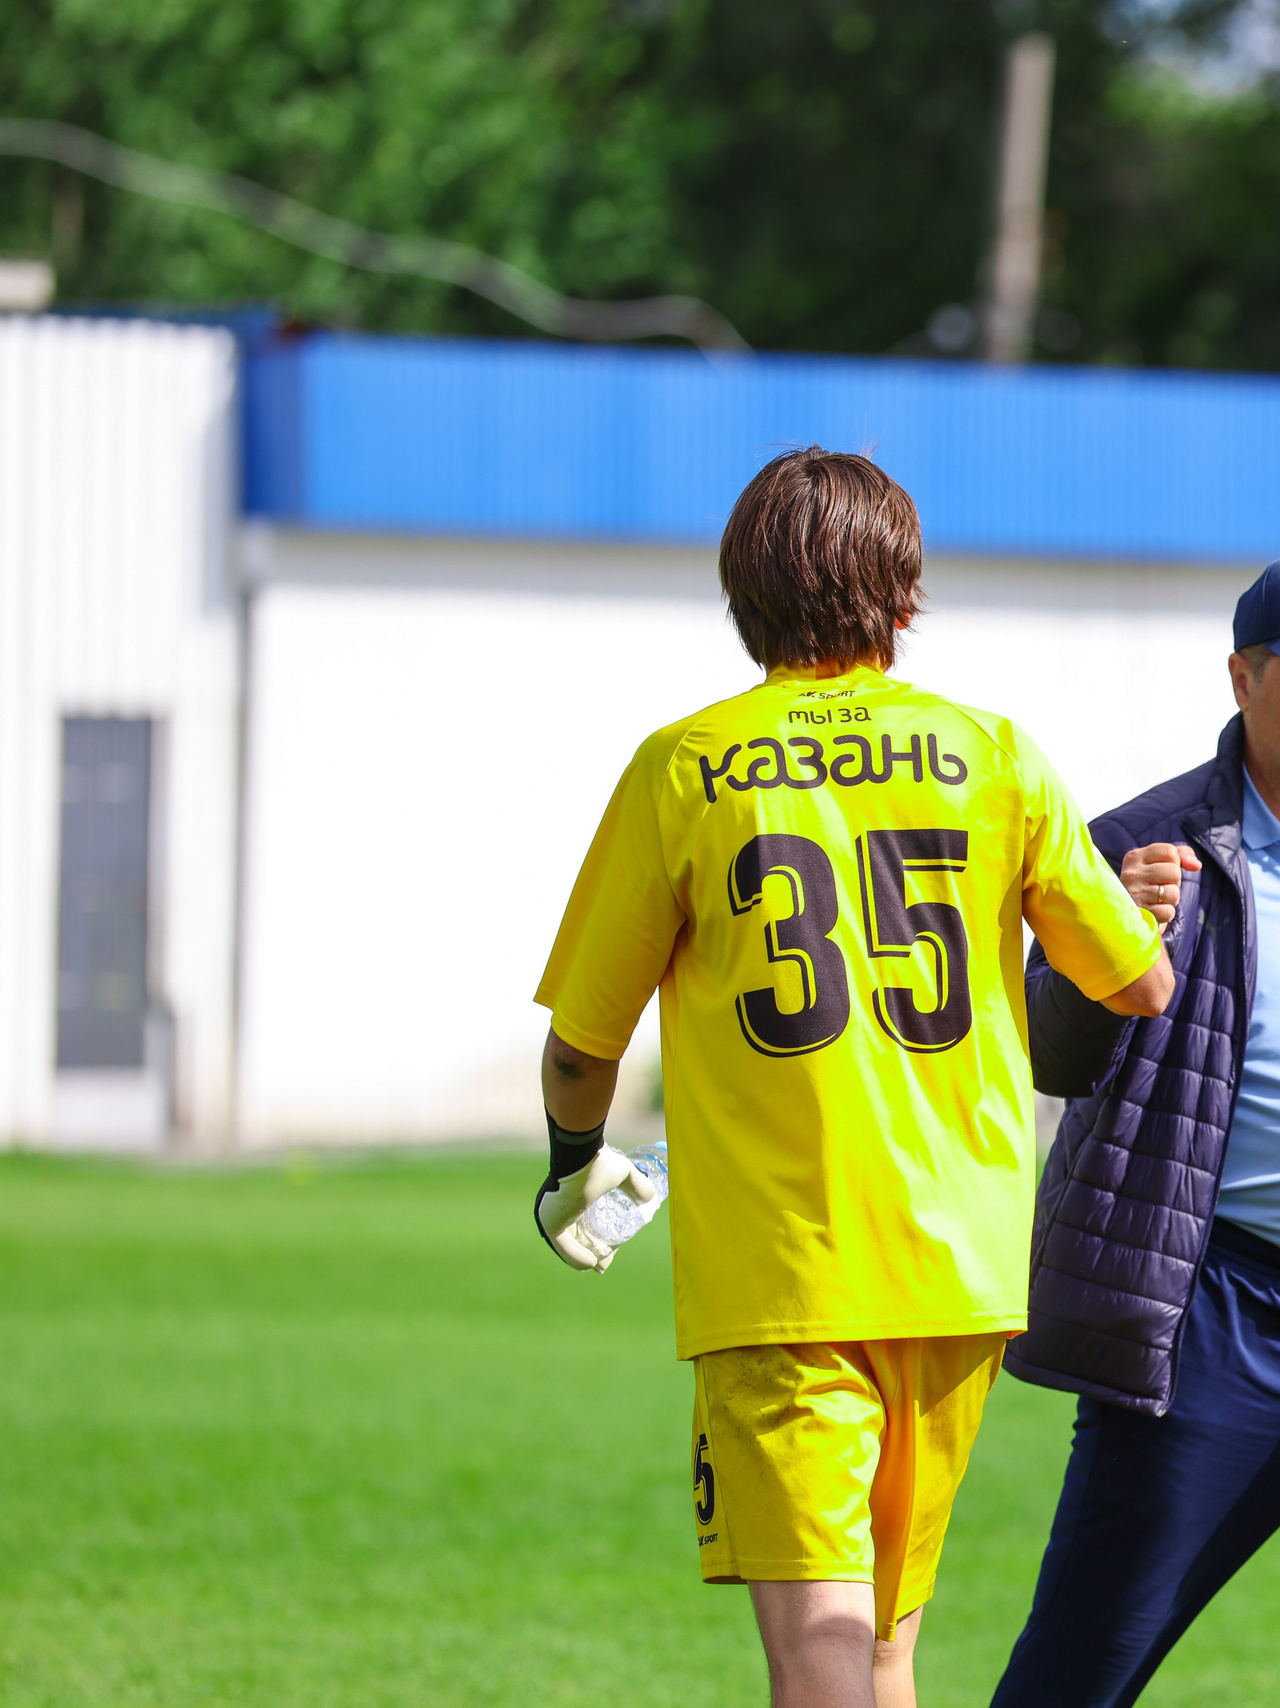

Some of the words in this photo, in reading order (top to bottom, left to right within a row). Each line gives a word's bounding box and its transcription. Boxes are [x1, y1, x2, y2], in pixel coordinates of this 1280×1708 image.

[818, 690, 855, 700] SPRT
[838, 707, 872, 723] за
[727, 828, 973, 1058] 35
